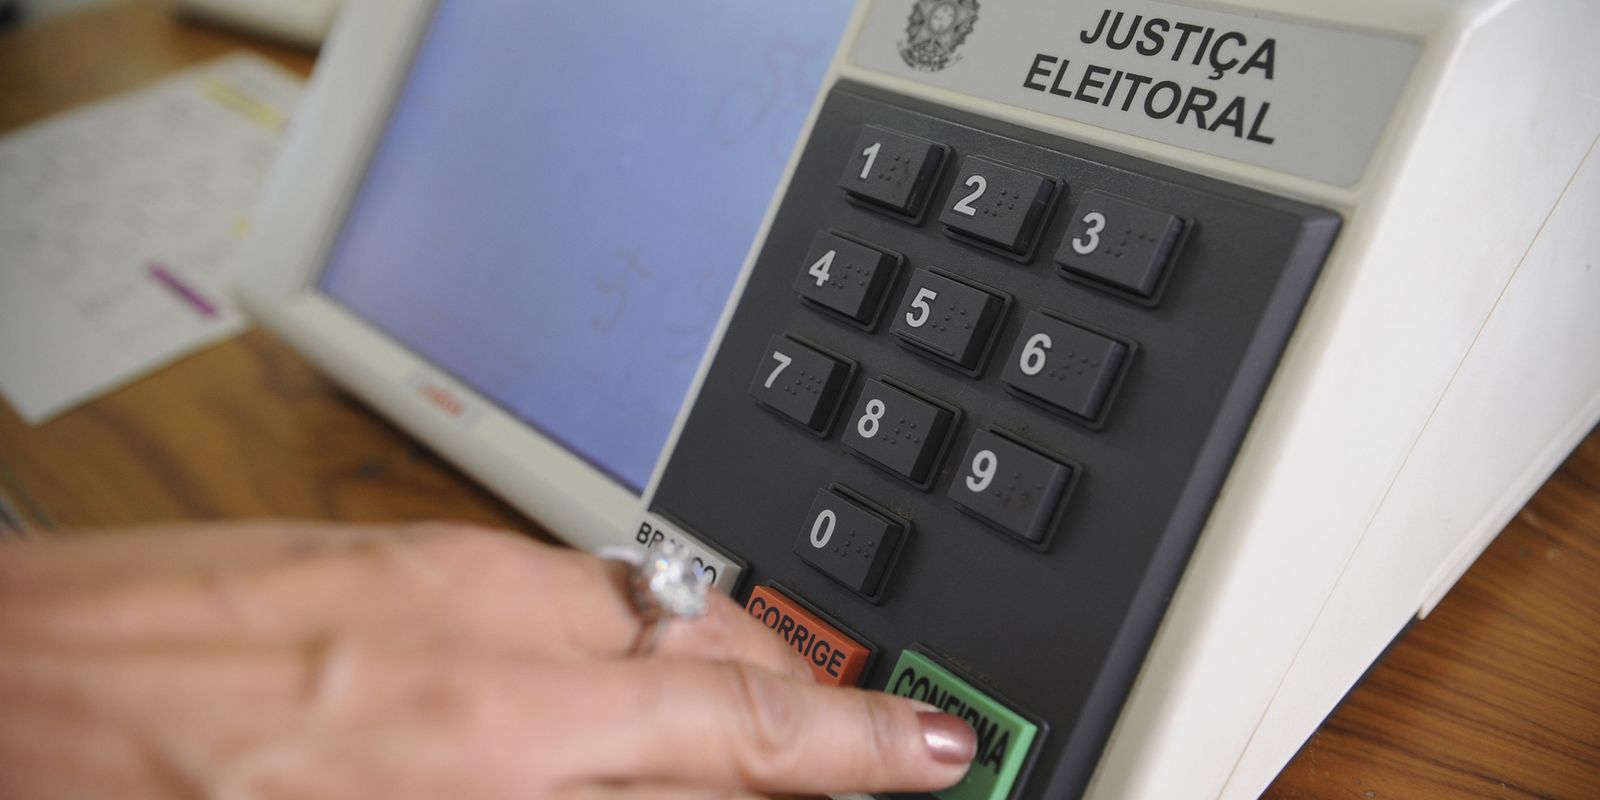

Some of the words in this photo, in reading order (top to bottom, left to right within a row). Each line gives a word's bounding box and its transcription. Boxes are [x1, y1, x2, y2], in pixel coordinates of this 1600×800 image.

[1080, 9, 1276, 81] JUSTIÇA
[1023, 53, 1275, 145] ELEITORAL
[860, 142, 881, 179] 1
[953, 175, 987, 216] 2
[1072, 212, 1106, 254] 3
[808, 249, 836, 287] 4
[905, 287, 938, 328] 5
[1019, 333, 1052, 375] 6
[764, 351, 793, 388] 7
[857, 398, 886, 439] 8
[965, 449, 998, 492] 9
[809, 509, 836, 549] 0
[748, 596, 847, 679] CORRIGE
